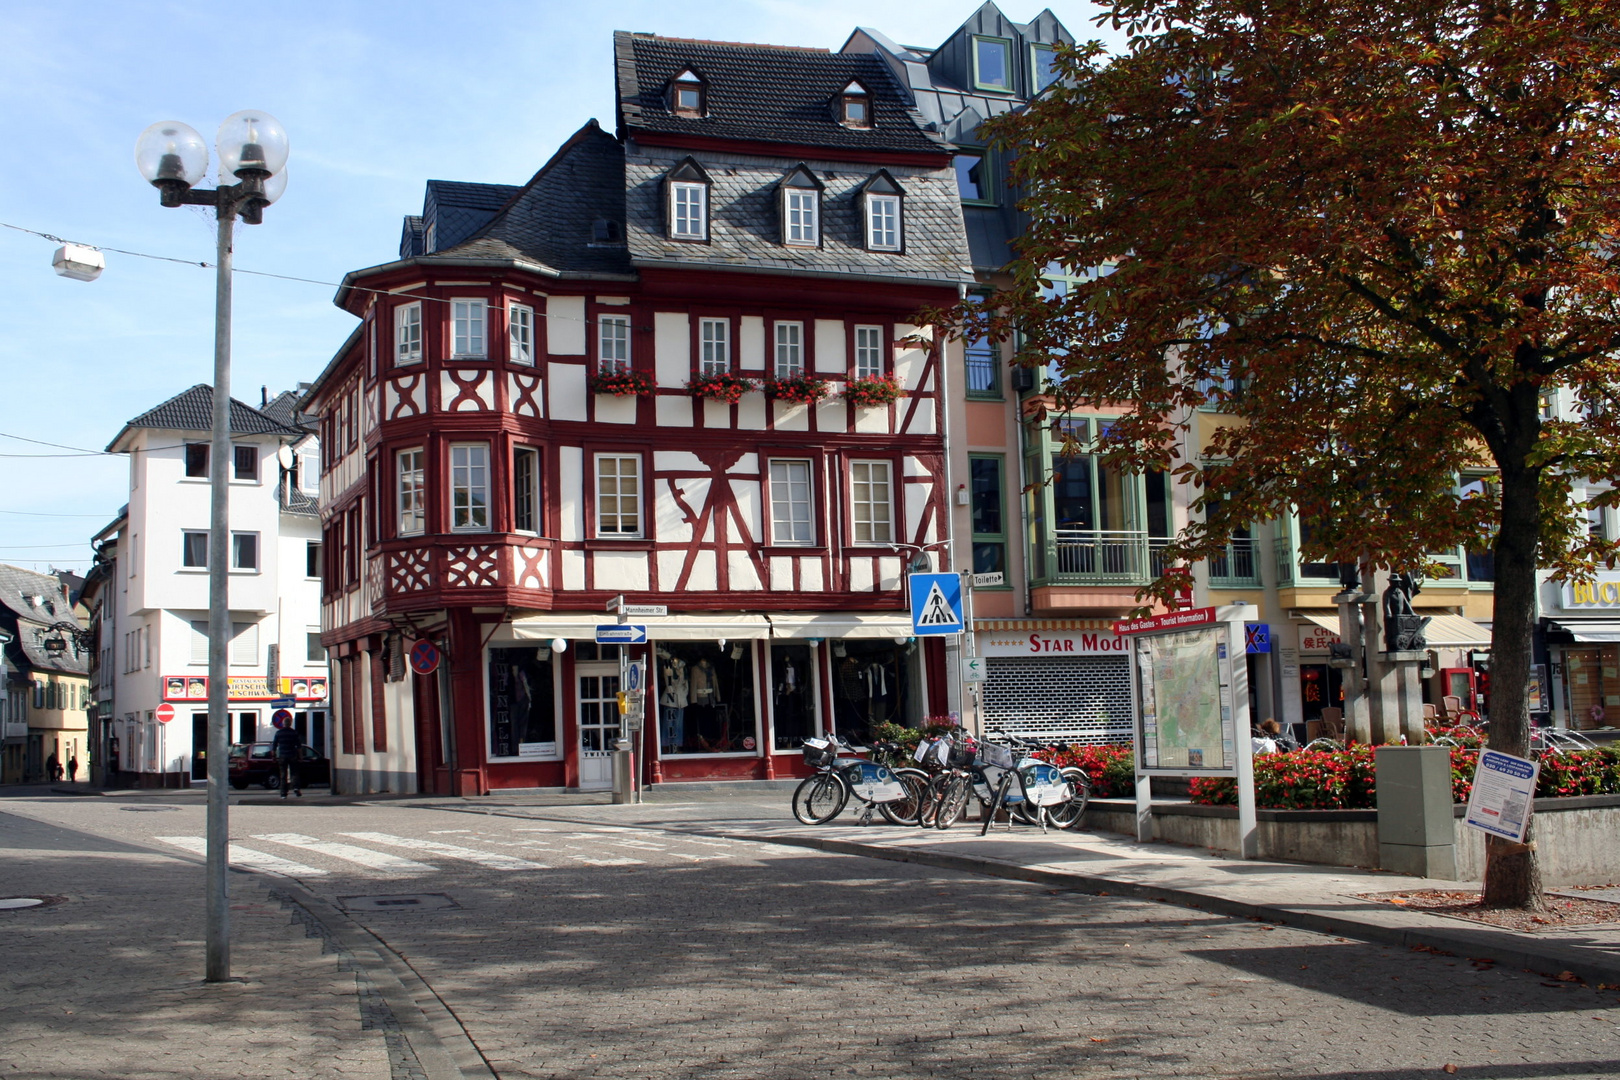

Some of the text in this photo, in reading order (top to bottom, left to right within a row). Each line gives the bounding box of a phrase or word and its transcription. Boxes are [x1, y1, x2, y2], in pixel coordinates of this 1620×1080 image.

[974, 576, 998, 584] Toilette
[1139, 620, 1155, 629] Gastes
[1160, 616, 1176, 626] Tourist
[1177, 612, 1204, 624] Information
